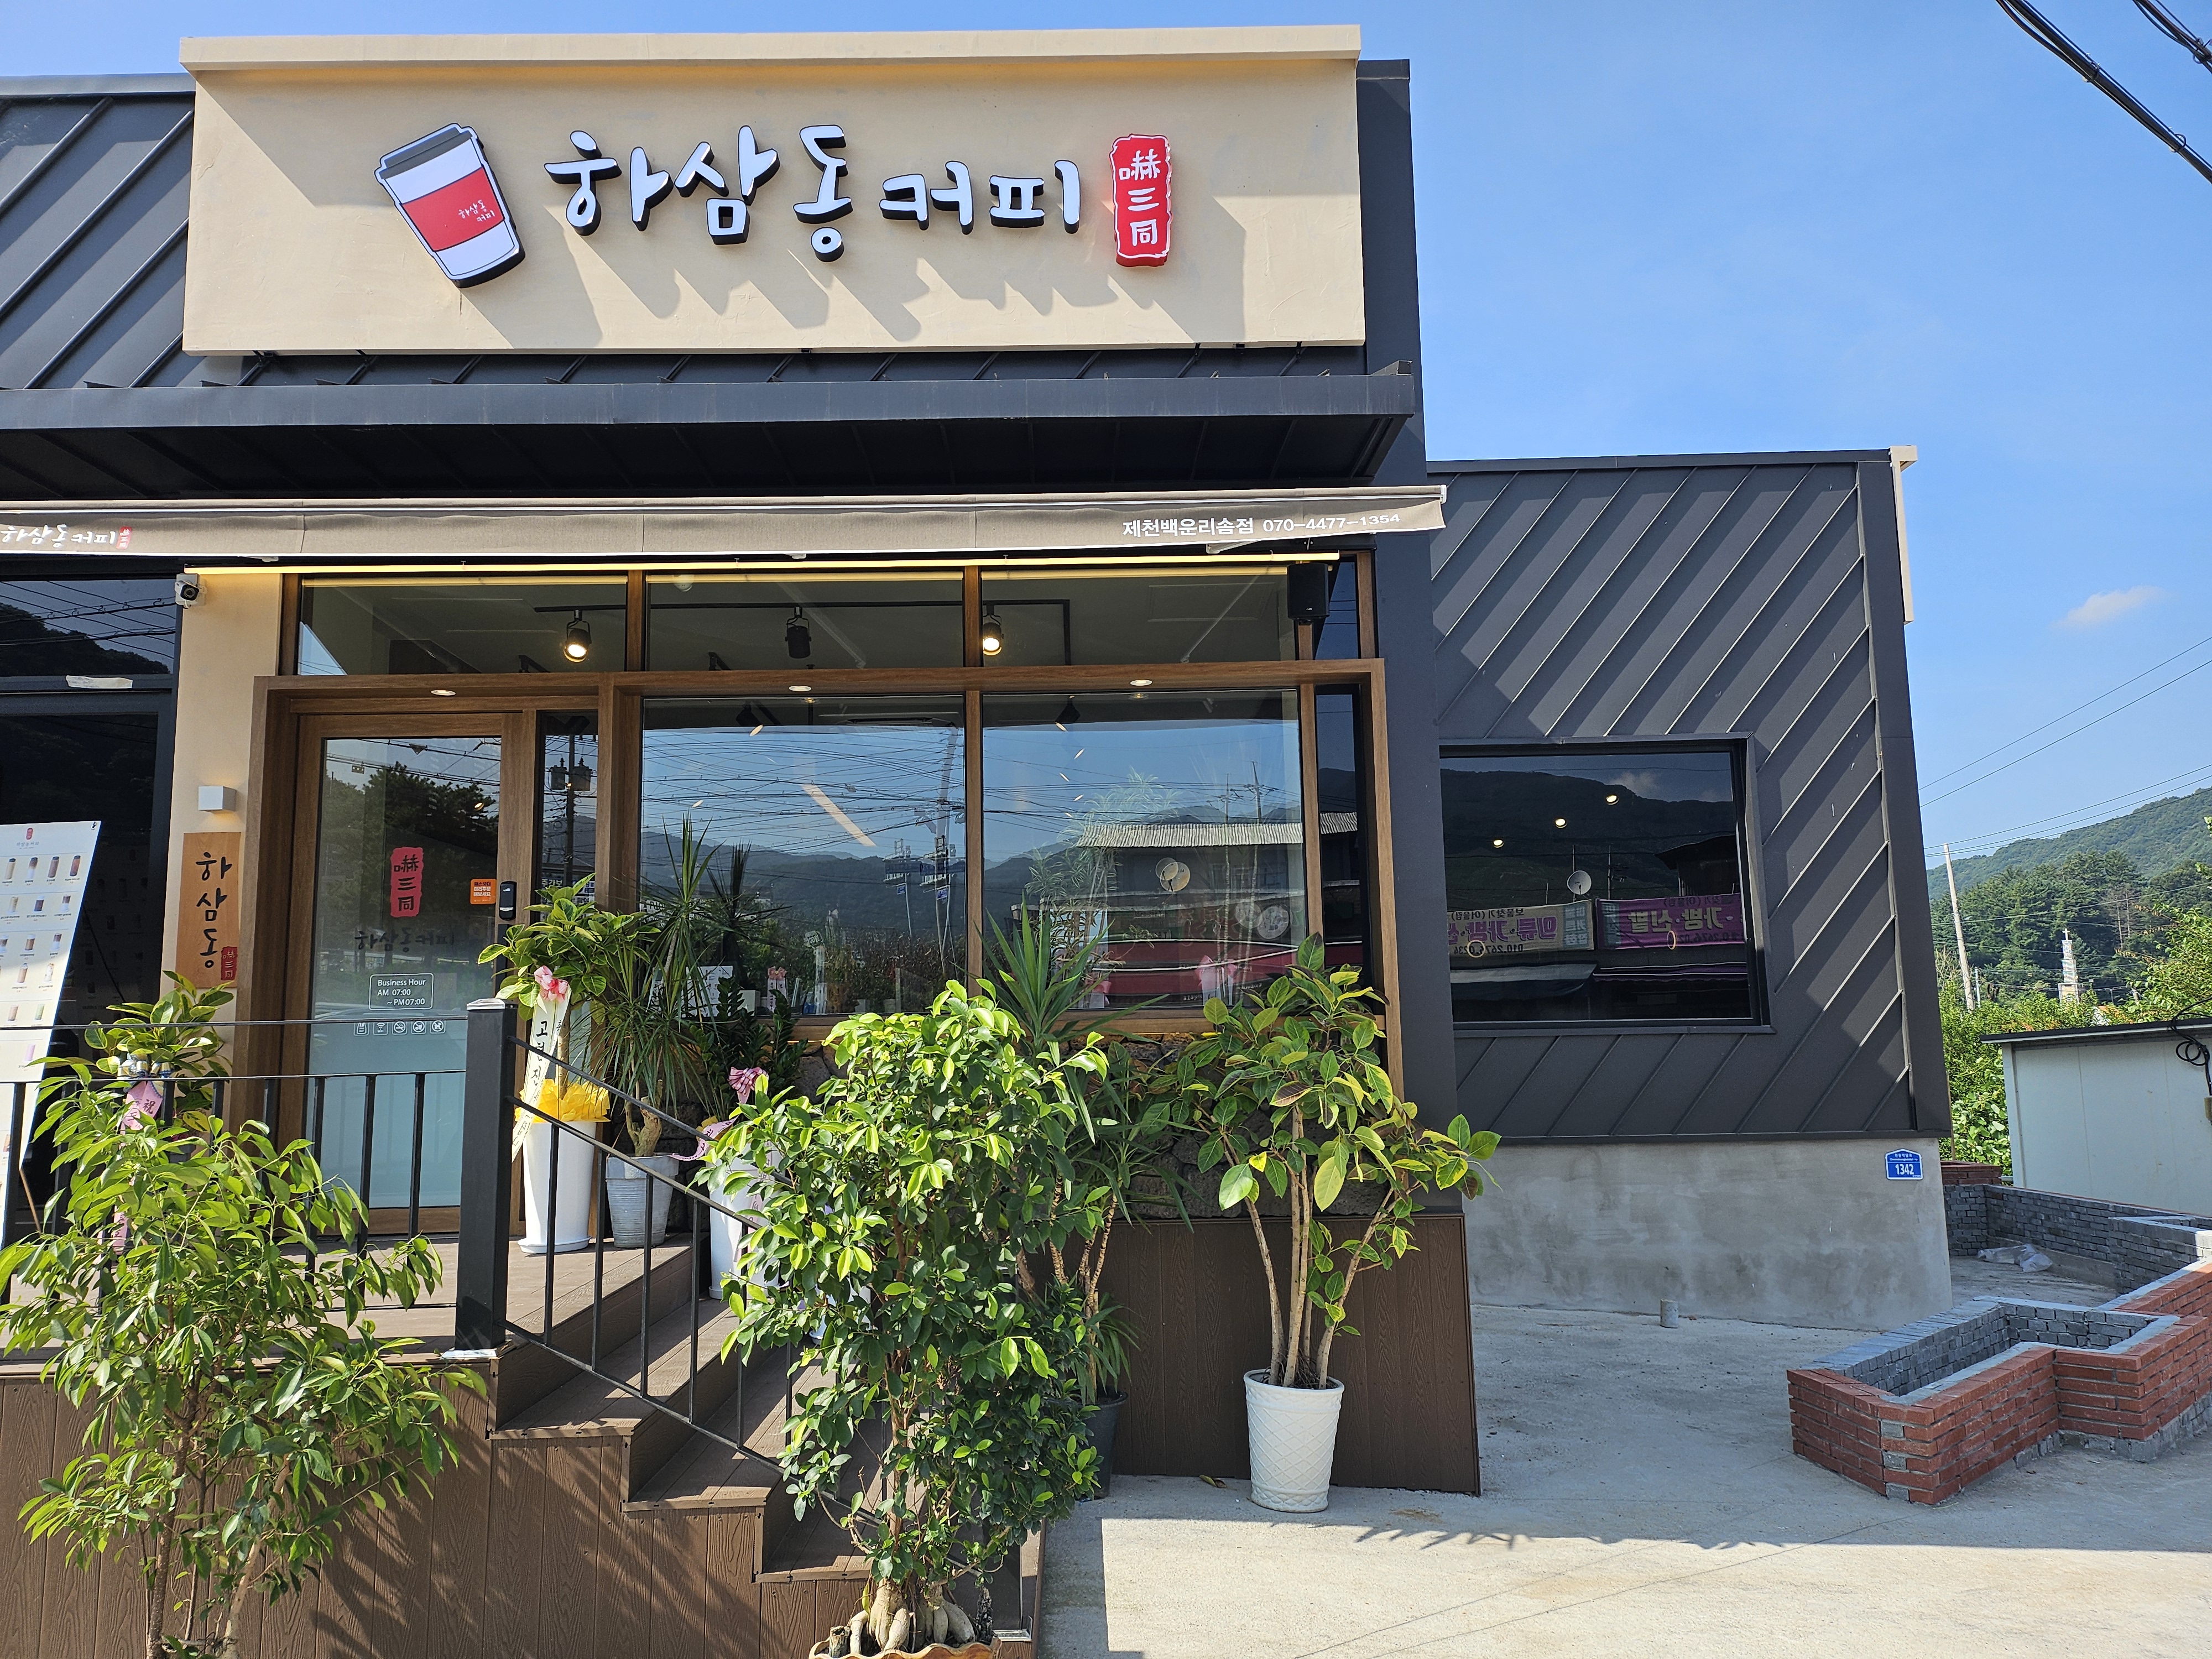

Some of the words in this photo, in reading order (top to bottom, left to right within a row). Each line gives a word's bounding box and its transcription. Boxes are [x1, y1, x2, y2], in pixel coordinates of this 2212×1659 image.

[458, 200, 487, 219] 하삼동
[476, 210, 495, 222] 커피
[1122, 517, 1254, 538] 제천백운리솜점
[1263, 514, 1401, 532] 070-4477-1354
[195, 852, 233, 968] 하삼동
[142, 1099, 156, 1114] 祝
[1895, 1164, 1914, 1175] 1342
